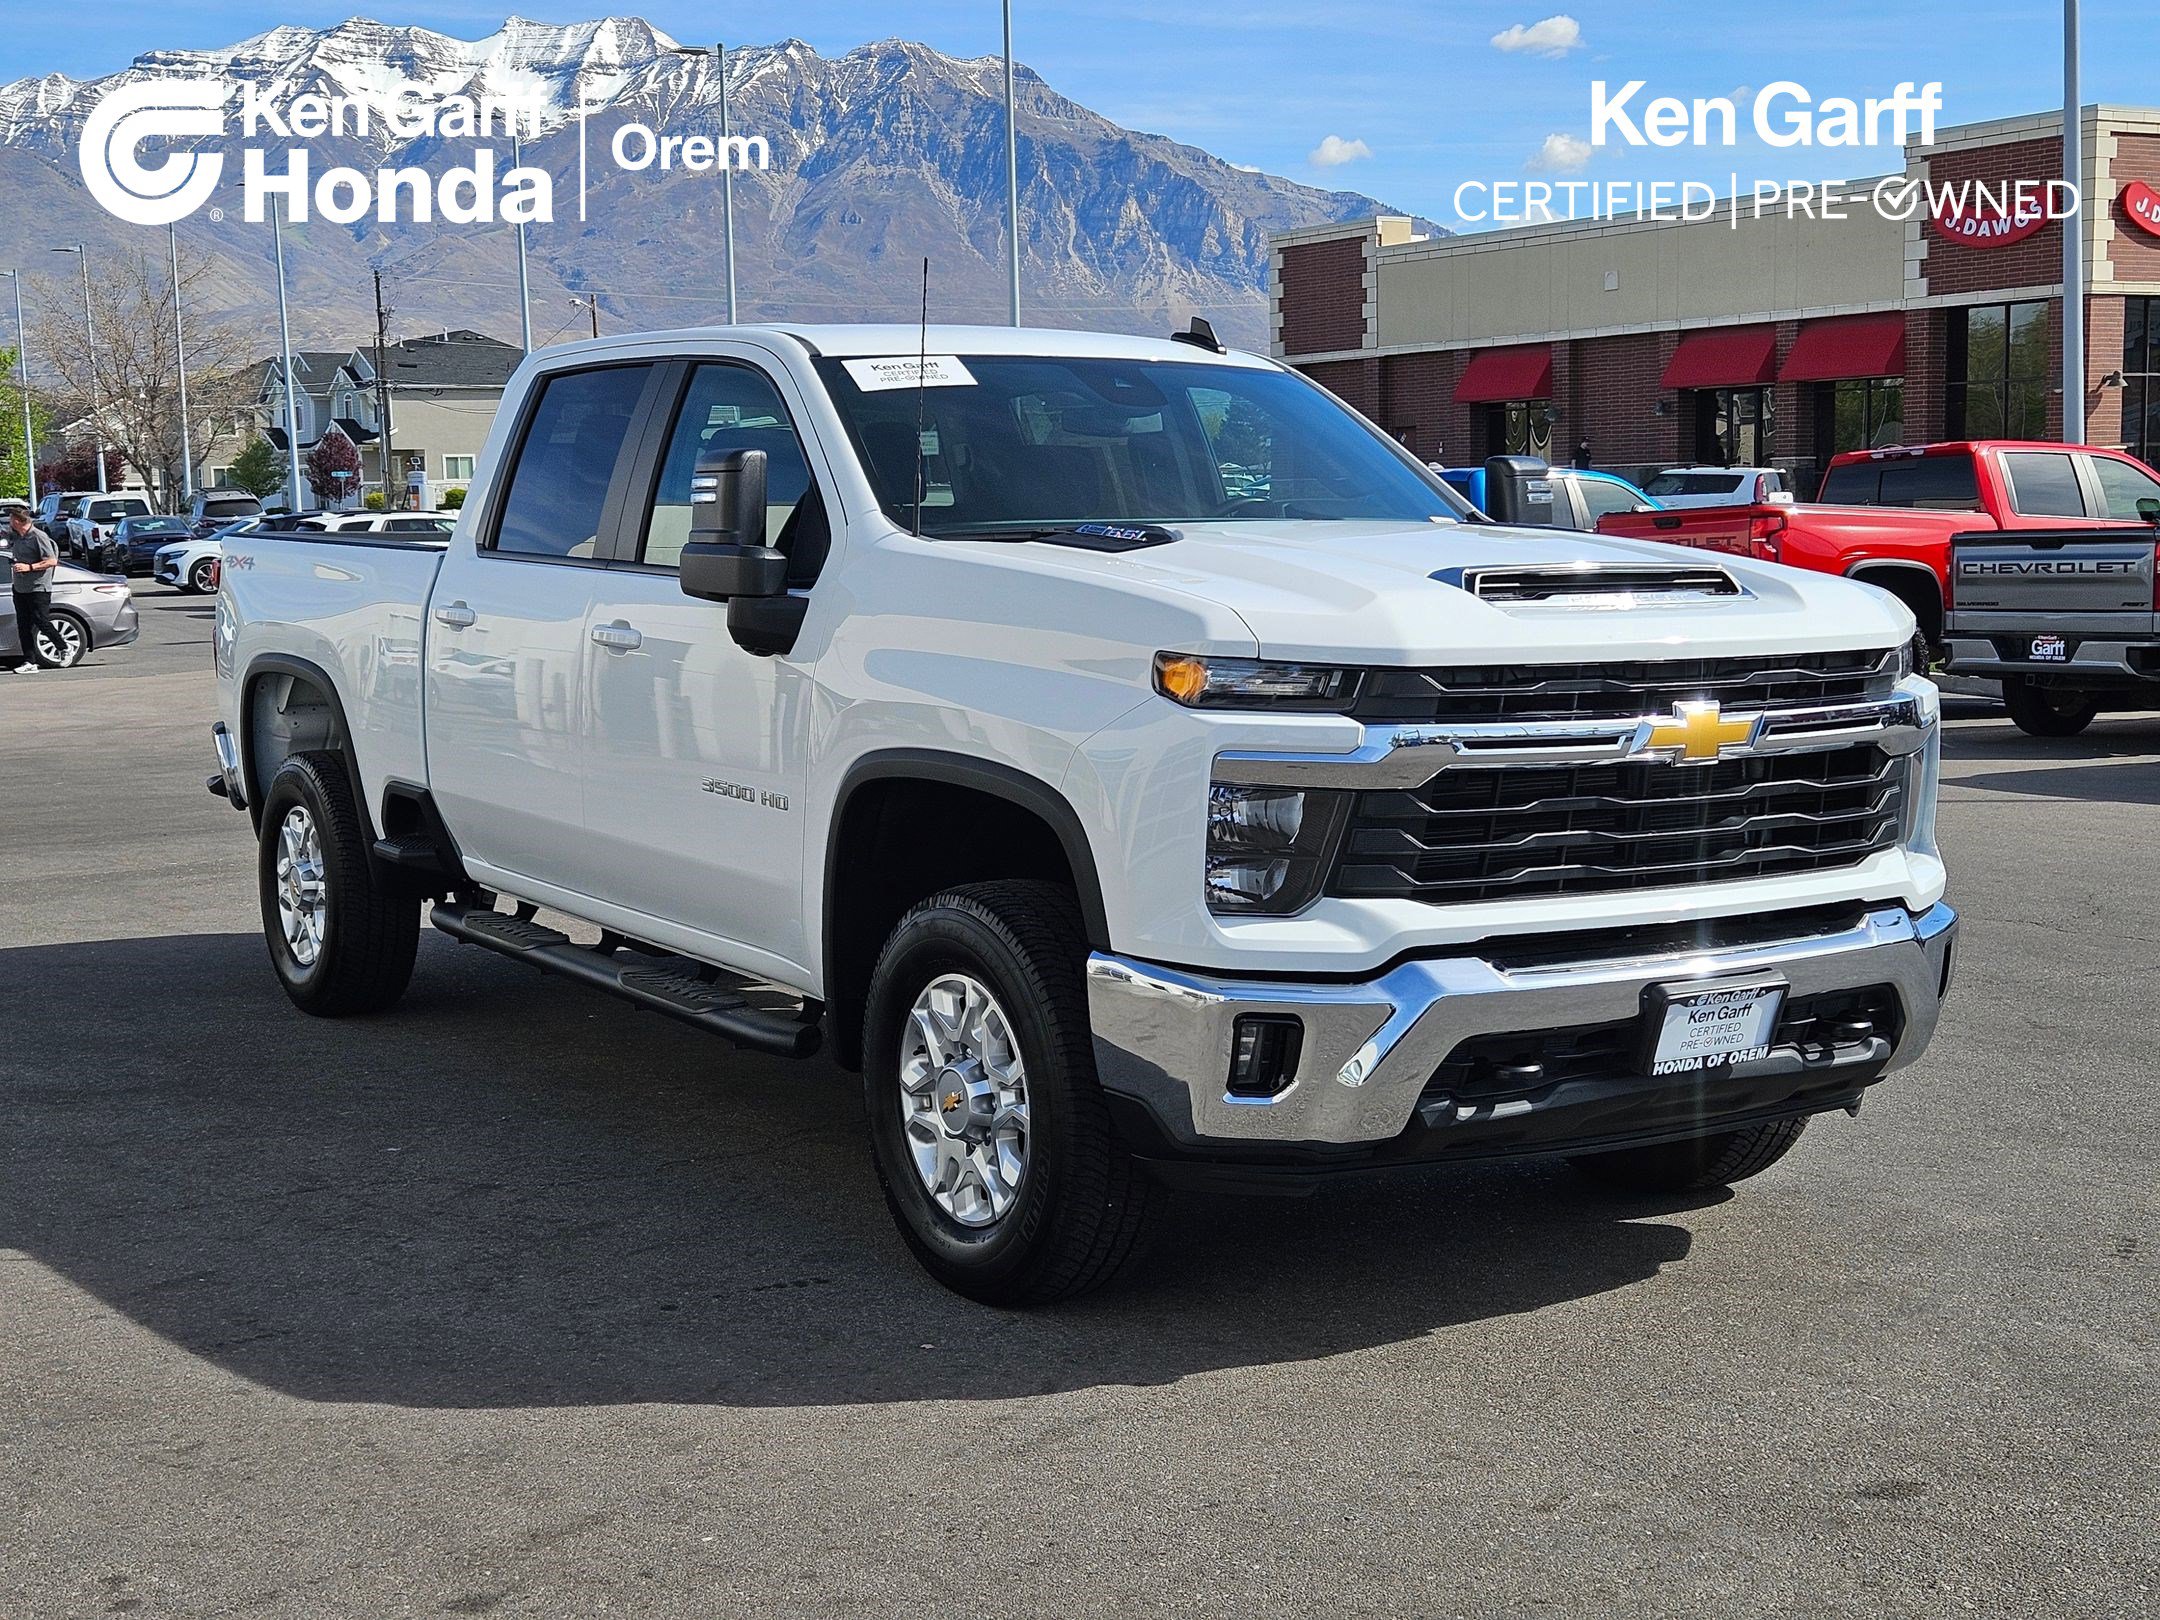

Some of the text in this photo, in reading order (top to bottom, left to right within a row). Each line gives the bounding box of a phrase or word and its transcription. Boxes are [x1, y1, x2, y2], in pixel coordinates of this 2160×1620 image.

[1962, 561, 2136, 575] CHEVROLET
[2031, 639, 2065, 655] Garff
[701, 775, 789, 811] 3500 HD
[1706, 988, 1760, 1005] Ken Garff
[1688, 1002, 1753, 1024] Ken Garff
[1689, 1022, 1742, 1038] CERTIFIED
[1652, 1046, 1769, 1076] HONDA OF OREM
